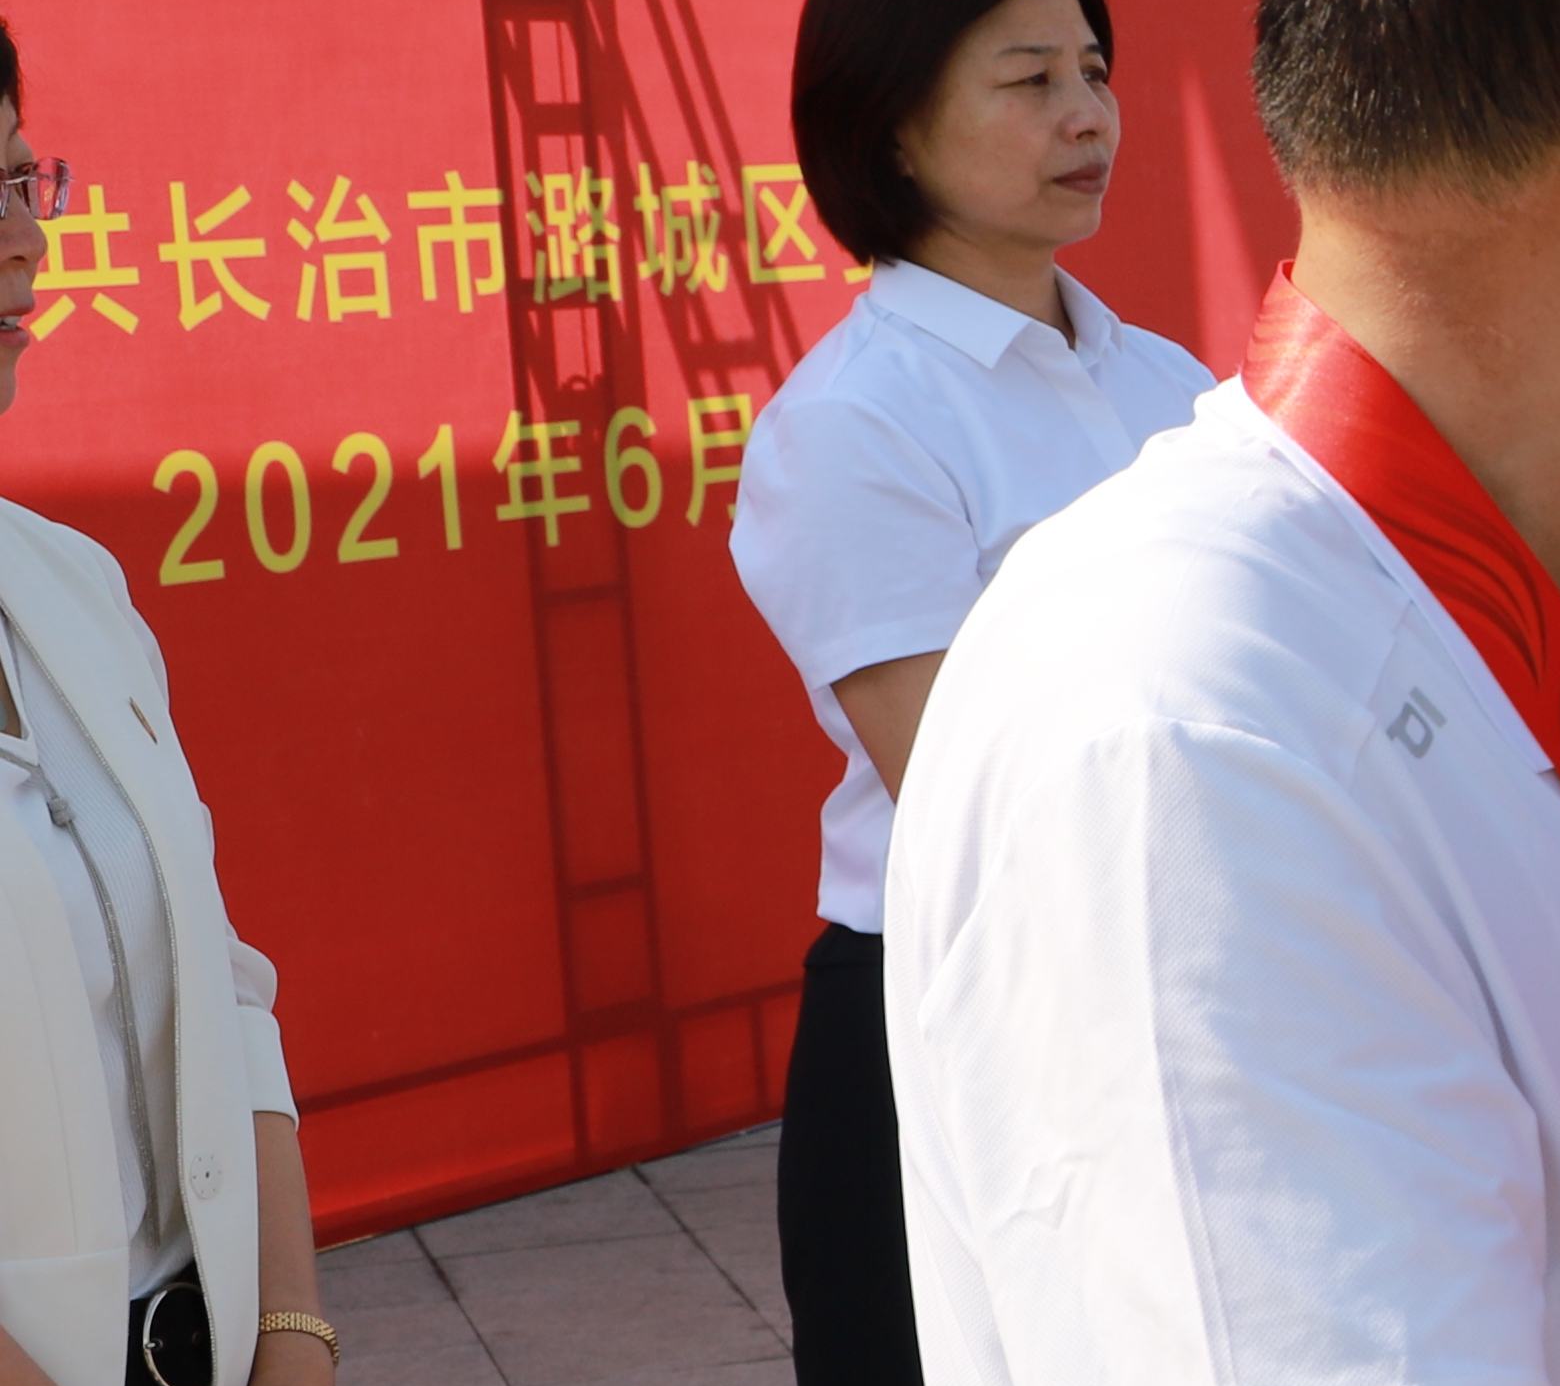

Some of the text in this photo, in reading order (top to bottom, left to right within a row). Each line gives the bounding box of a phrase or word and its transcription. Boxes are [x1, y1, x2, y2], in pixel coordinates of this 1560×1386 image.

[29, 160, 877, 343] 共长治市潞城区
[153, 393, 754, 586] 2021年6月
